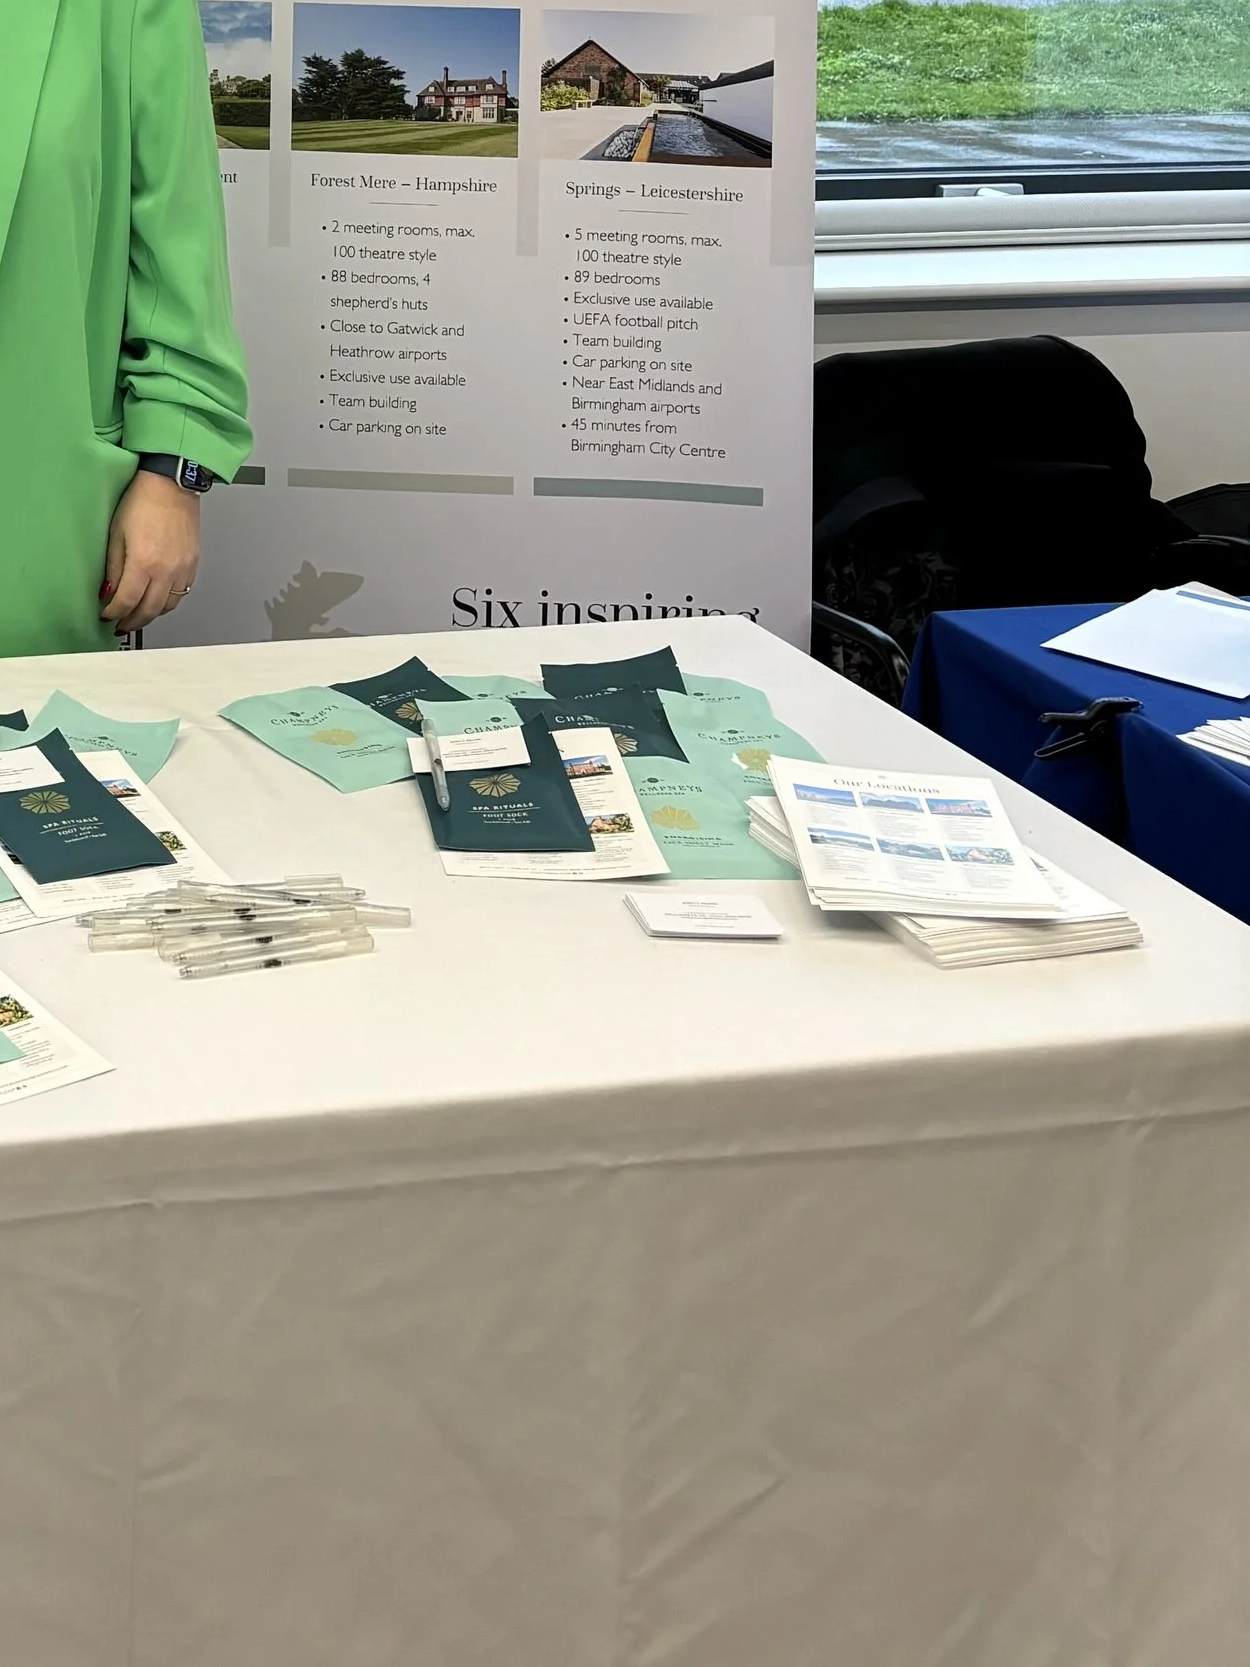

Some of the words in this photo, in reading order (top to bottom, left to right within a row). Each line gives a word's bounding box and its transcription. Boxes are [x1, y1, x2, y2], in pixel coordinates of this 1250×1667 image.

[310, 172, 356, 188] Forest
[358, 174, 397, 190] Mere
[415, 176, 498, 196] Hampshire
[565, 181, 621, 200] Springs
[640, 183, 744, 203] Leicestershire
[333, 244, 356, 259] 100
[358, 246, 406, 260] theatre
[408, 248, 437, 264] style
[330, 269, 347, 283] 88
[422, 273, 431, 286] 4
[329, 318, 367, 334] Close
[368, 322, 384, 334] to
[386, 321, 439, 336] Gatwick
[441, 324, 465, 337] and
[330, 343, 395, 359] Heathrow
[398, 349, 448, 363] airports
[572, 375, 606, 389] Near
[609, 376, 635, 390] East
[638, 377, 696, 394] Midlands
[698, 382, 723, 396] and
[572, 396, 647, 415] Birmingham
[650, 402, 701, 417] airports
[451, 586, 523, 629] Six
